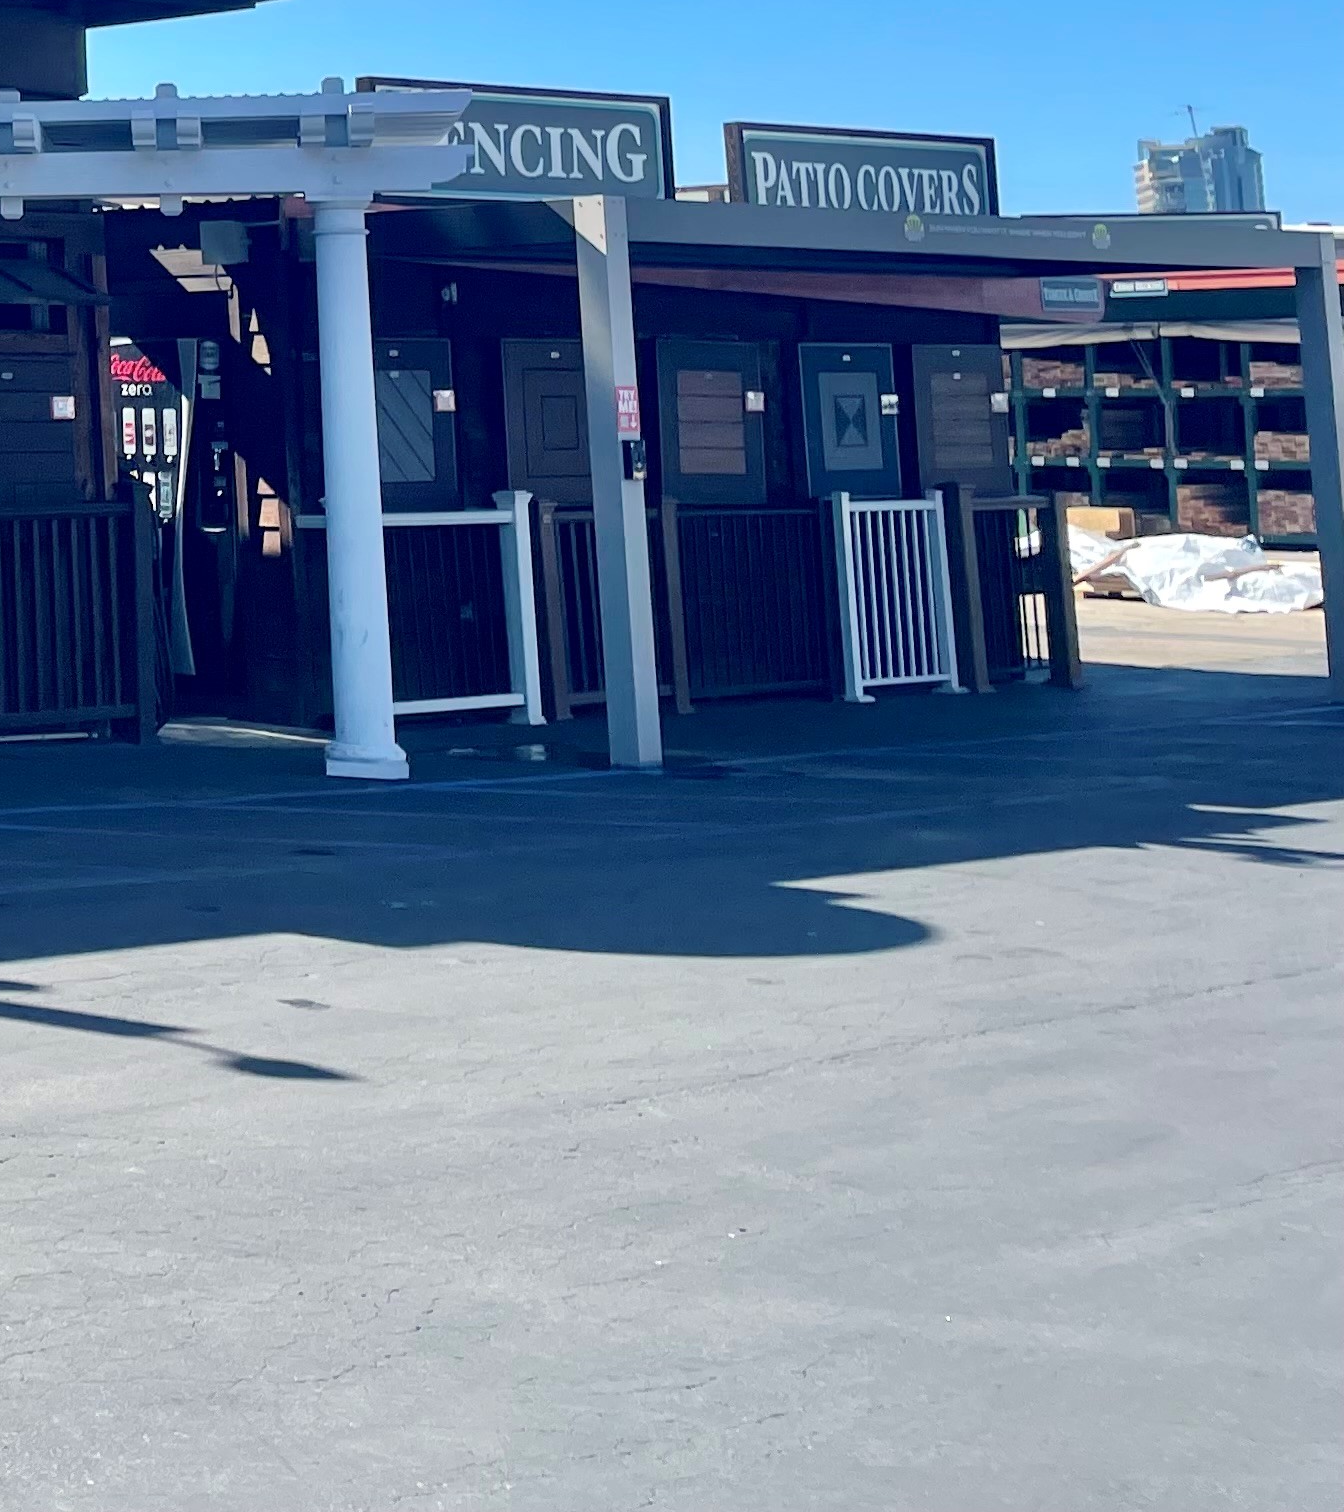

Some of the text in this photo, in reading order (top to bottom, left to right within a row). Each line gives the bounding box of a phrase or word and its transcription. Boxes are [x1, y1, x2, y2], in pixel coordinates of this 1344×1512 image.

[436, 120, 648, 184] NCING
[750, 151, 981, 216] PATIO COVERS
[121, 383, 153, 397] zero
[618, 389, 635, 401] TRY
